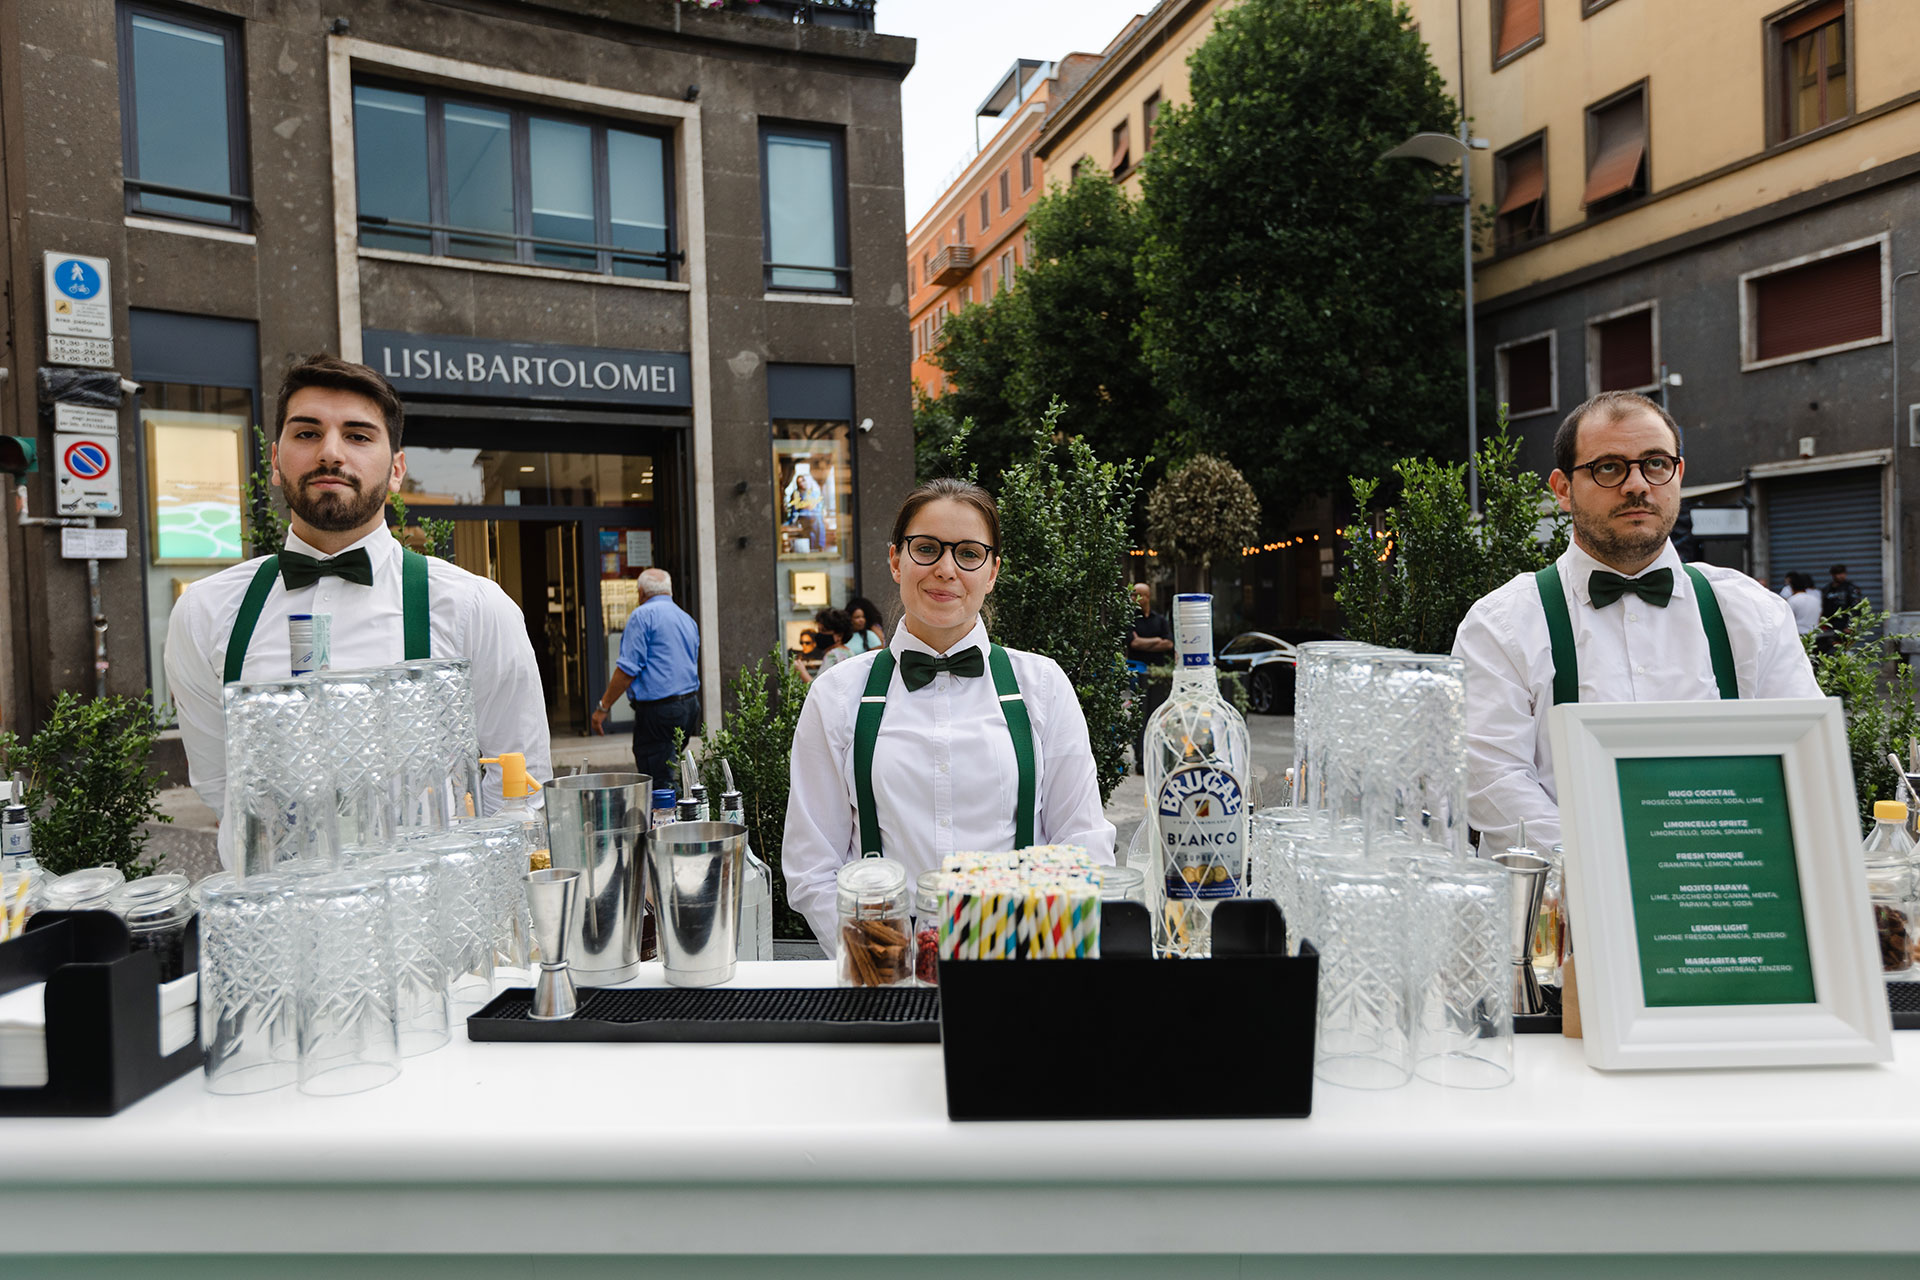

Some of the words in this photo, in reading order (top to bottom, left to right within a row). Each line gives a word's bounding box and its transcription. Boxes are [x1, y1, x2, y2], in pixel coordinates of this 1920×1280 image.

[383, 347, 676, 393] LISI&BARTOLOMEI
[1161, 770, 1241, 814] BRUGAL
[1167, 831, 1237, 846] BLANCO
[1706, 852, 1744, 860] TONIQUE
[1685, 957, 1736, 965] MARGARITA
